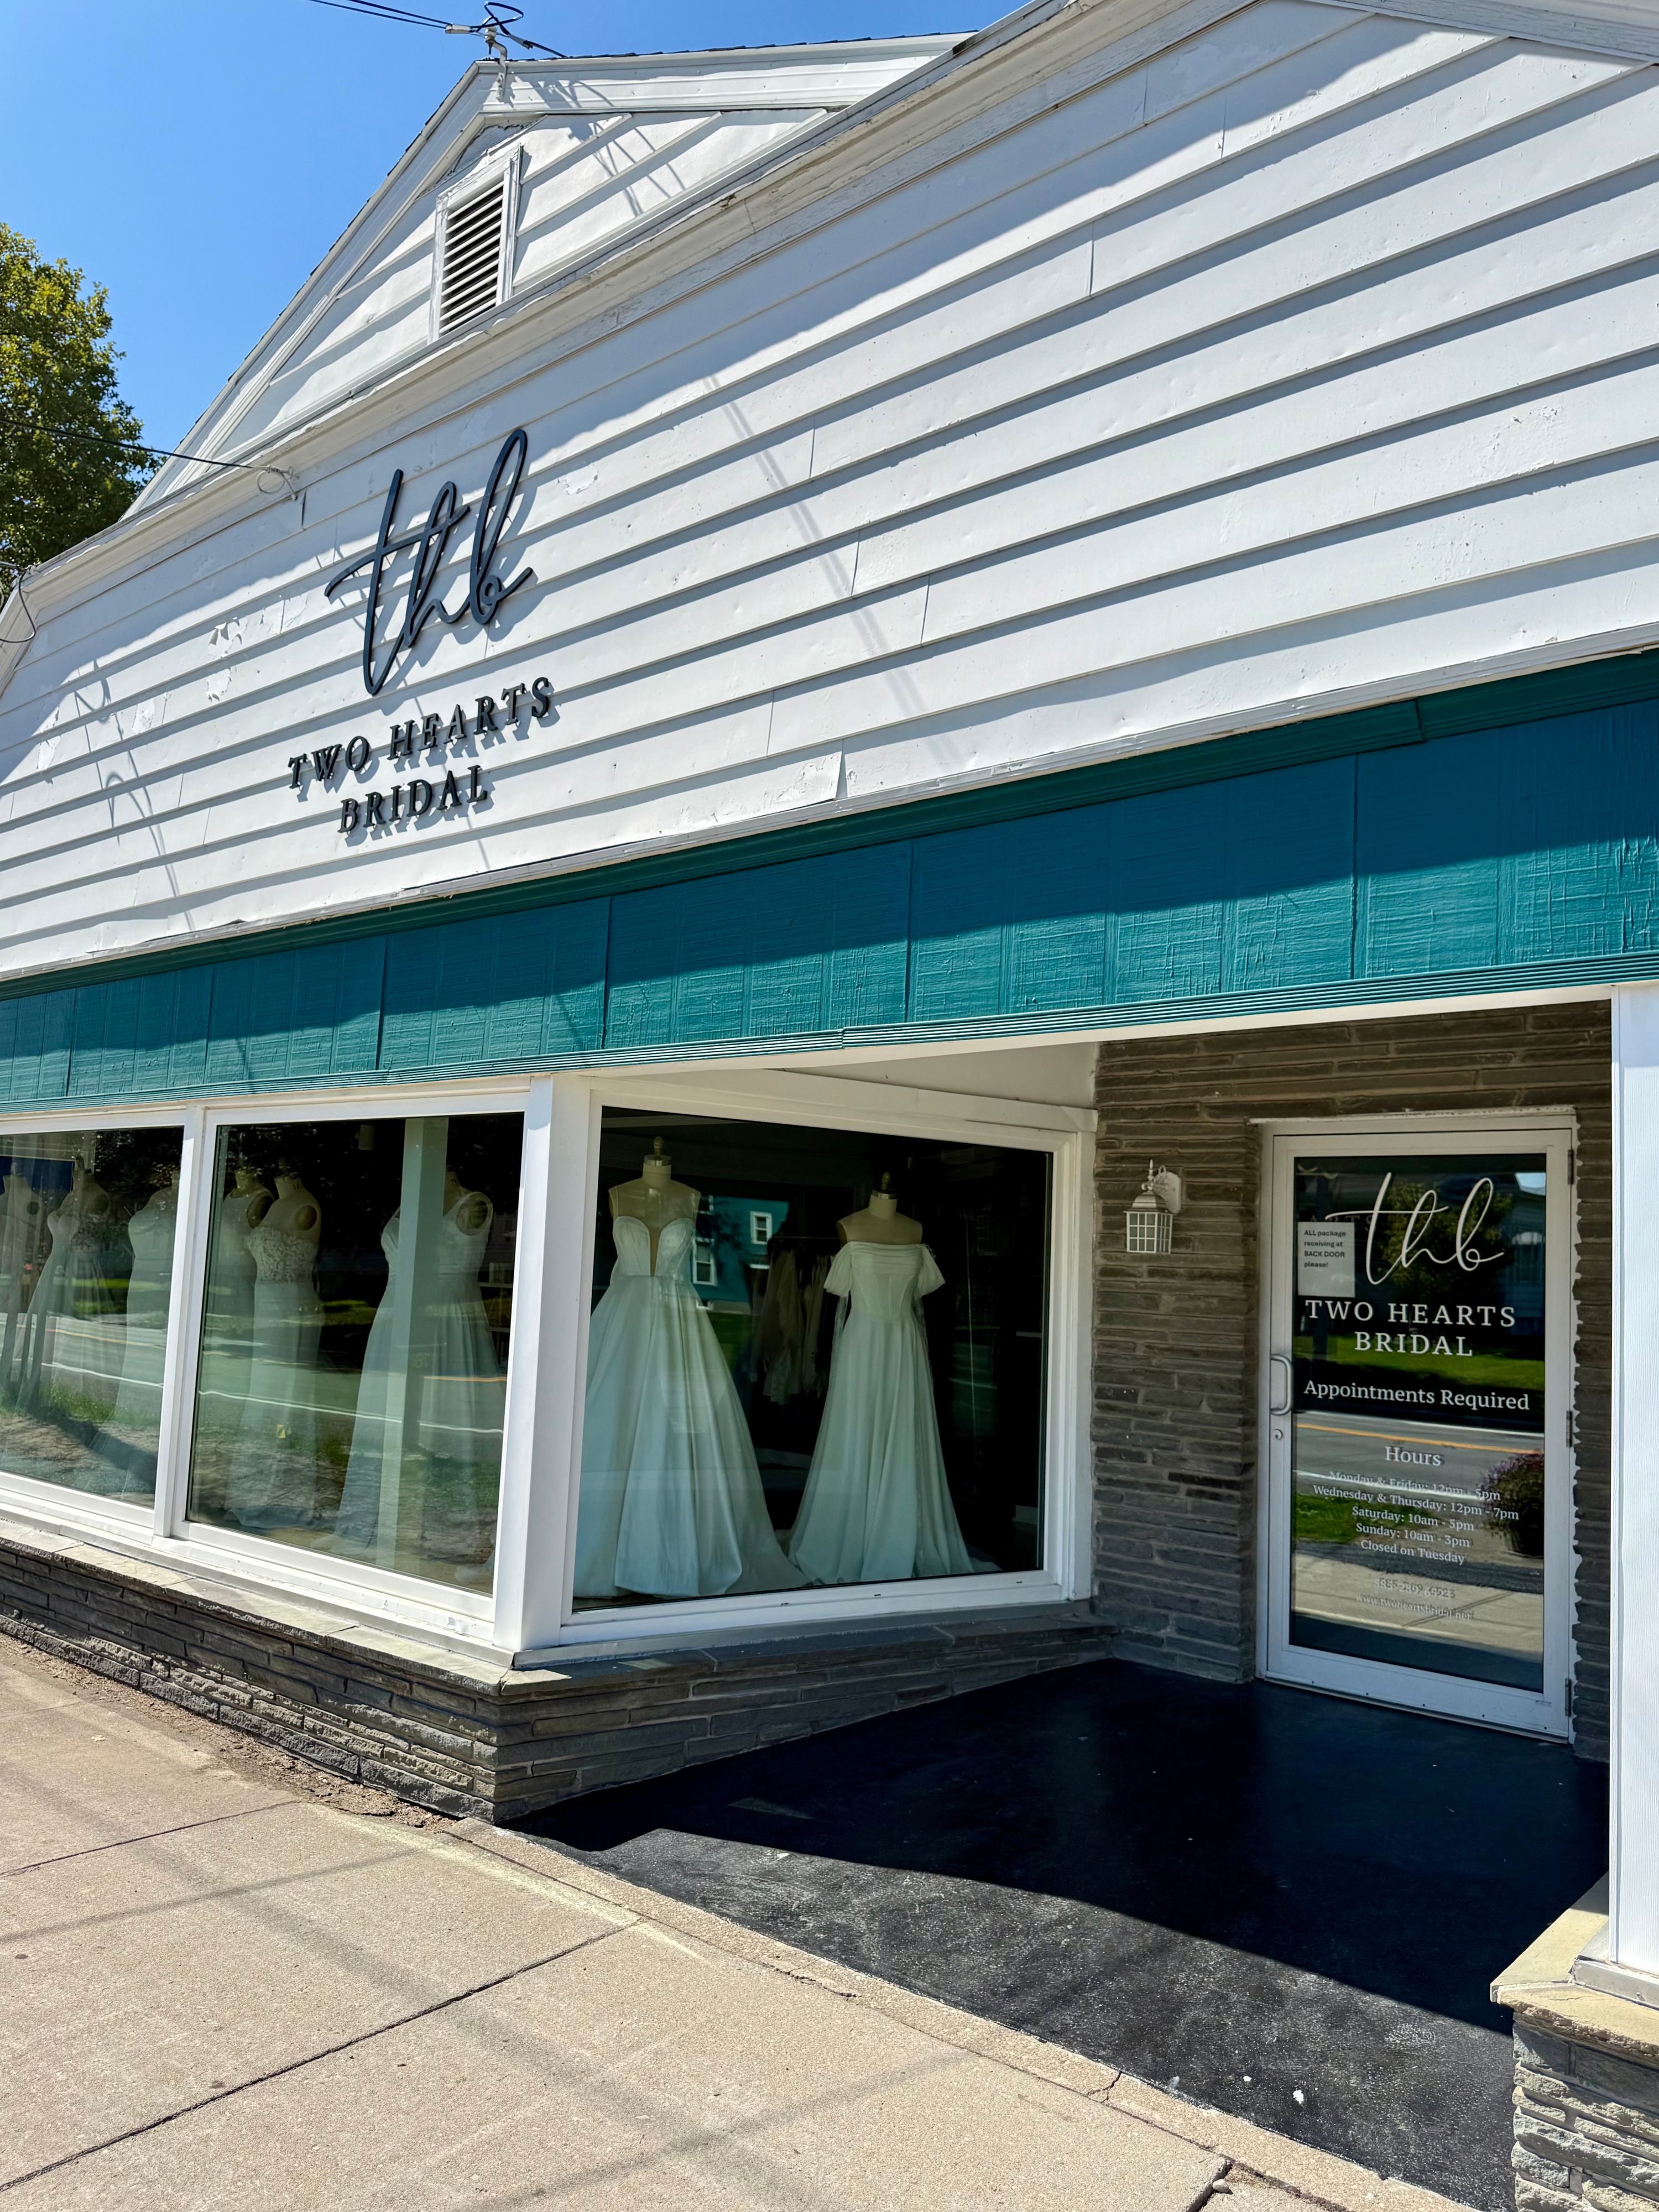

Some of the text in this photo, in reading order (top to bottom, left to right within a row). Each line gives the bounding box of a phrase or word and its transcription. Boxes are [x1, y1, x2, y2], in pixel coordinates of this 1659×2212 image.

[288, 677, 554, 789] TWO HEARTS
[338, 764, 488, 833] BRIDAL
[1305, 1300, 1516, 1328] TWO HEARTS
[1354, 1331, 1473, 1357] BRIDAL
[1303, 1381, 1530, 1411] Appointments Required
[1385, 1446, 1441, 1466] Hours
[1329, 1471, 1373, 1486] Monday
[1378, 1477, 1386, 1486] &
[1433, 1484, 1463, 1497] 12pm
[1475, 1489, 1500, 1501] 5pm
[1313, 1485, 1374, 1503] Wednesday
[1377, 1494, 1386, 1503] &
[1390, 1495, 1447, 1511] Thursday:
[1451, 1503, 1482, 1516] 12pm
[1493, 1507, 1519, 1520] 7pm
[1352, 1506, 1405, 1522] Saturday:
[1408, 1514, 1438, 1526] 10am
[1449, 1519, 1474, 1531] 5pm
[1356, 1523, 1400, 1538] Sunday:
[1404, 1530, 1433, 1542] 10am
[1444, 1535, 1470, 1547] 3pm
[1360, 1540, 1465, 1565] Closed on Tuesday
